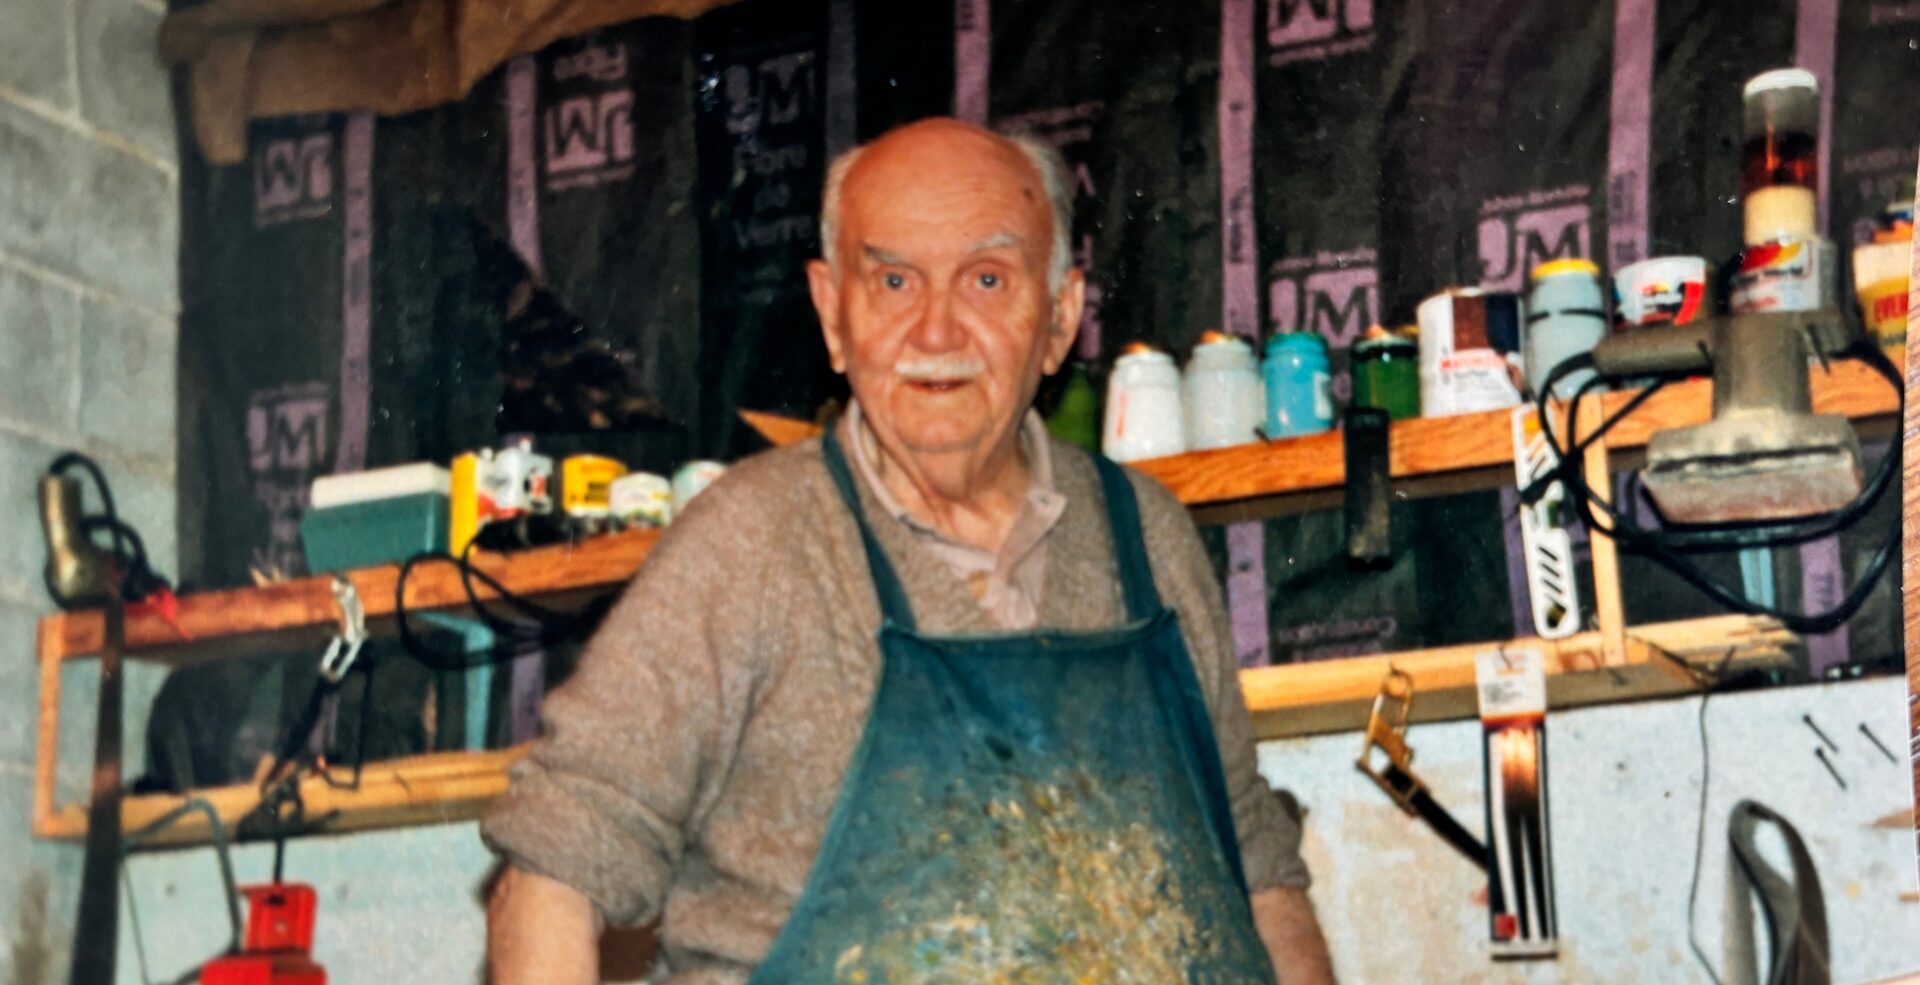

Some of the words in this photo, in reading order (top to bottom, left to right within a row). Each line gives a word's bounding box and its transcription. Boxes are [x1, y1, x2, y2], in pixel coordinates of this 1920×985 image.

[545, 90, 635, 172] JM
[725, 49, 816, 135] JM
[253, 133, 334, 210] JM
[1477, 203, 1591, 294] JM
[1268, 265, 1380, 349] JM
[245, 396, 330, 473] JM
